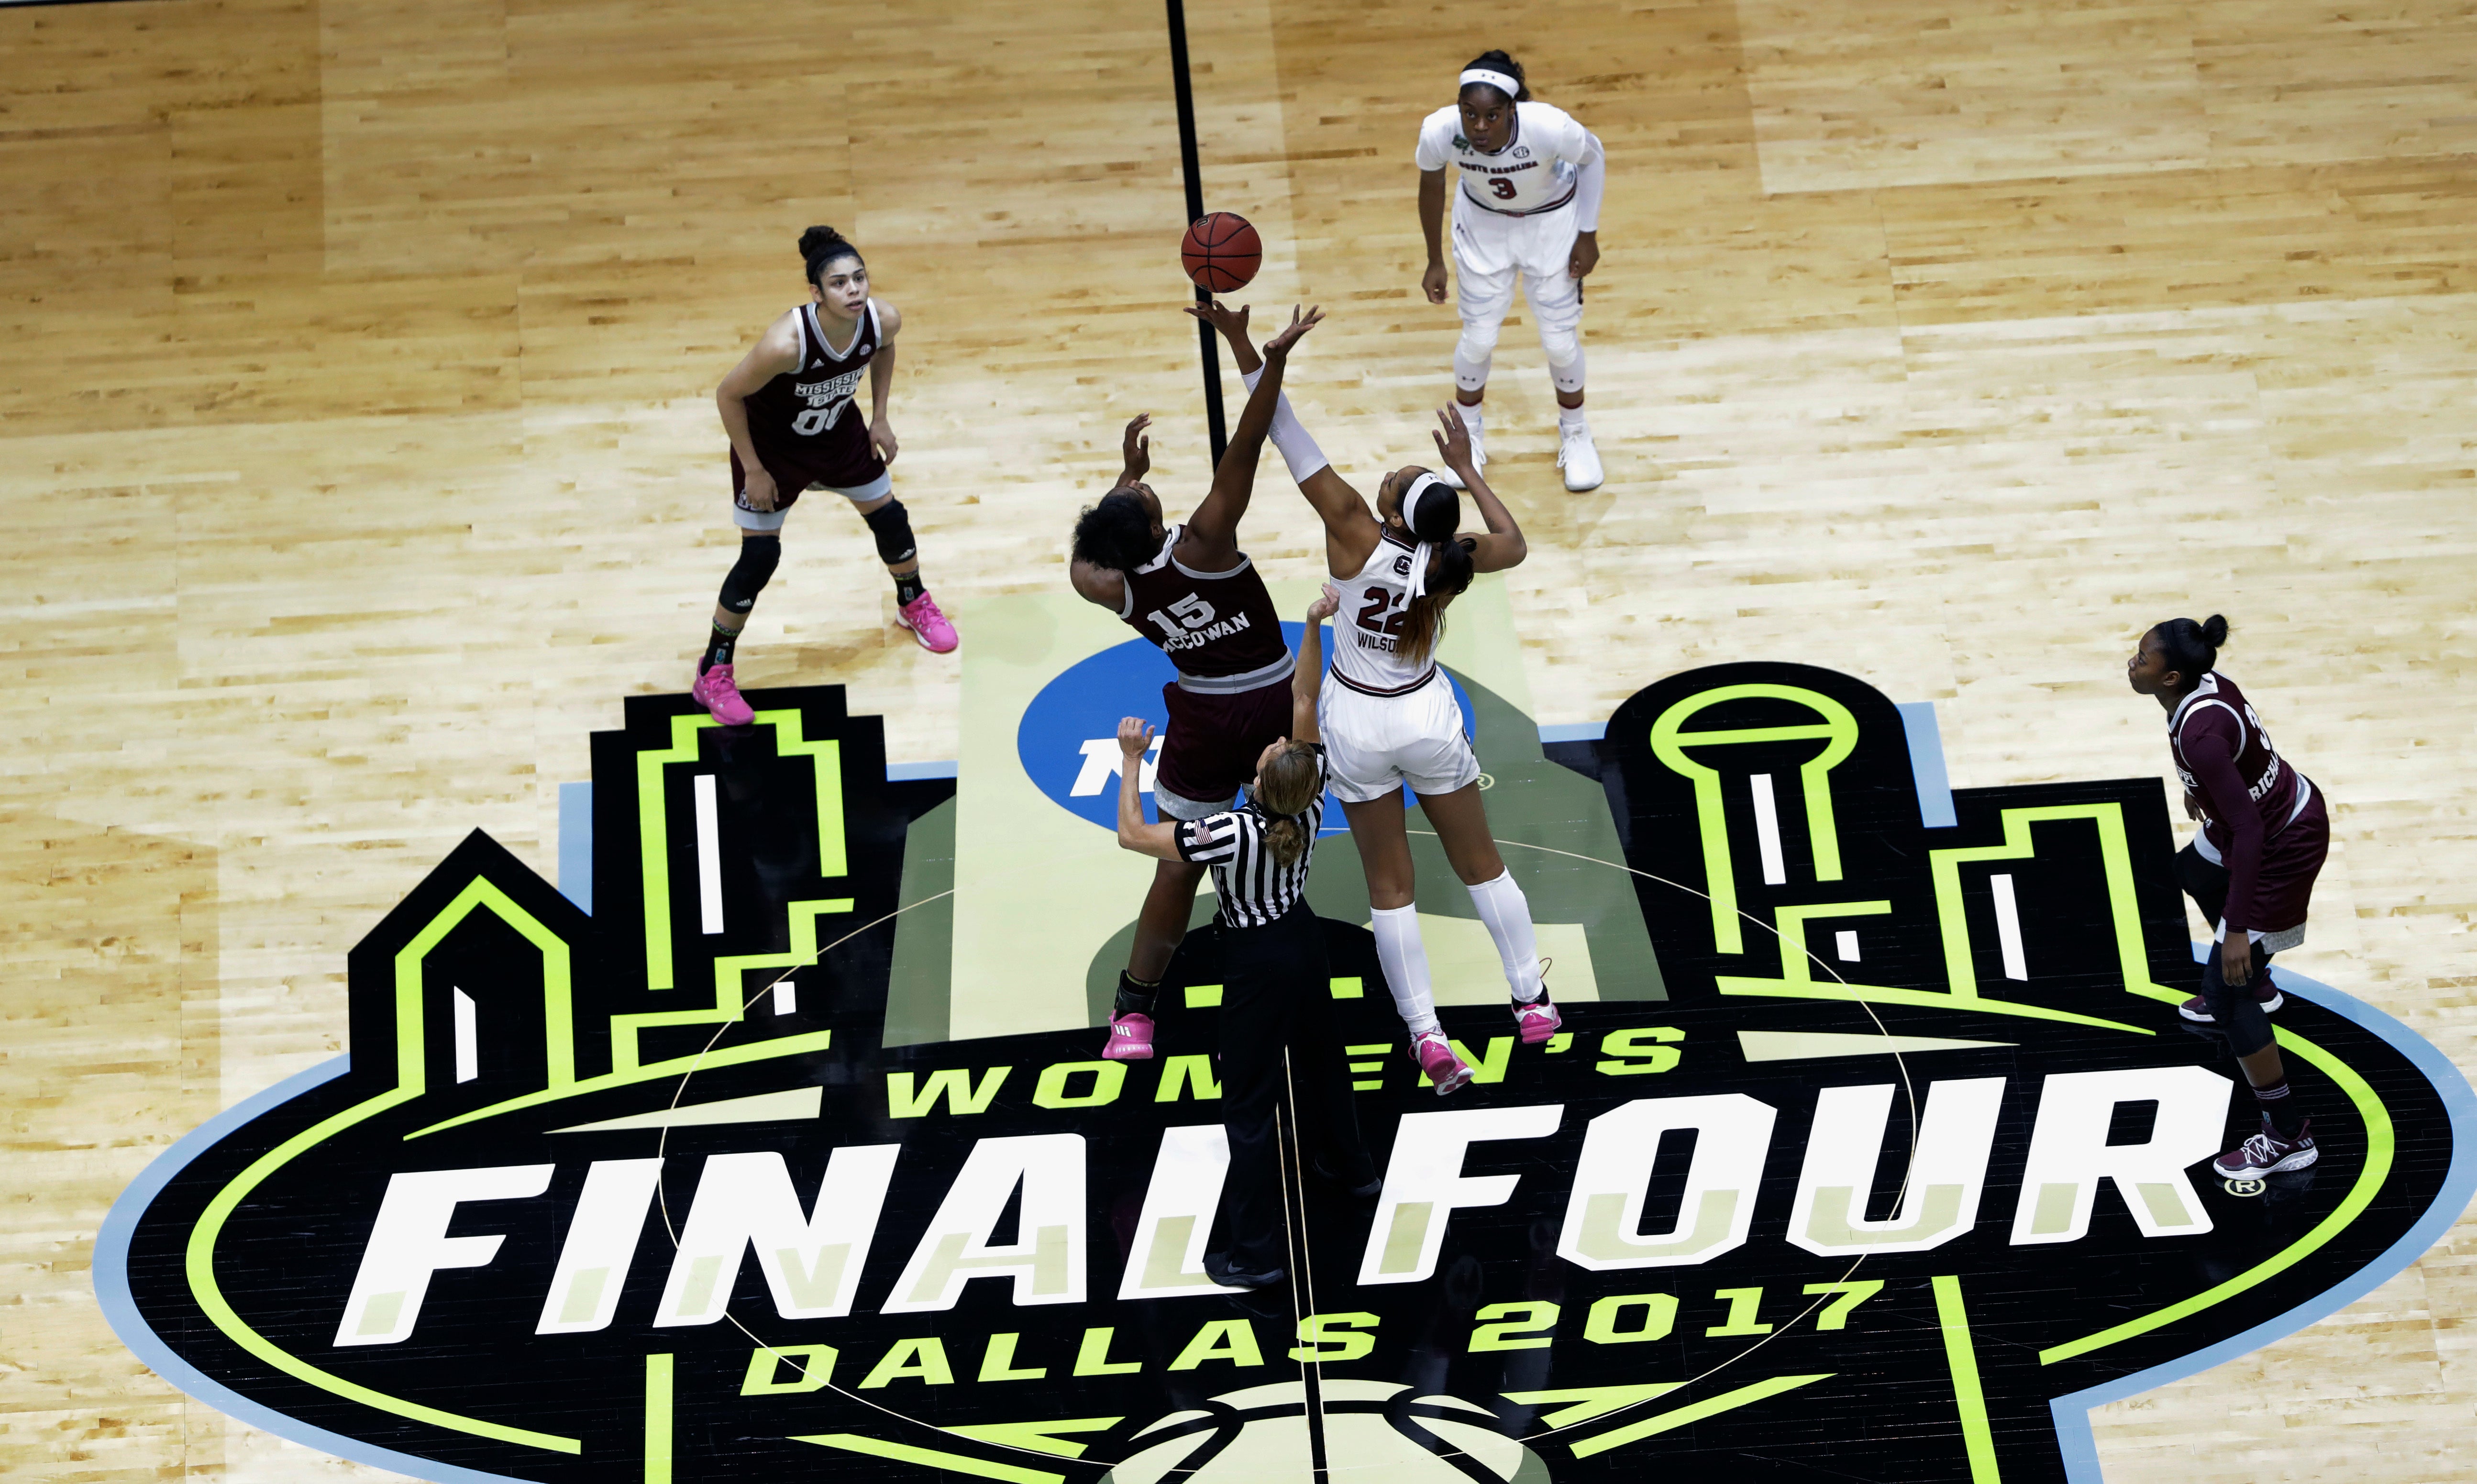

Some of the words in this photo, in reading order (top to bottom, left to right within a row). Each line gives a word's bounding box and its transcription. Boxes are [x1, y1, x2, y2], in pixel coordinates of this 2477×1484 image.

[1490, 160, 1539, 174] CAROLINA
[1488, 177, 1517, 200] 3
[795, 365, 868, 395] MISSISSIP
[817, 385, 852, 404] STATE
[1147, 592, 1216, 638] 15
[1356, 586, 1405, 635] 22
[1357, 631, 1398, 653] WILSO
[332, 1123, 1258, 1347] FINAL
[1356, 1065, 2234, 1285] FOUR
[740, 1311, 1381, 1396] DALLAS
[1468, 1279, 1885, 1352] 2017
